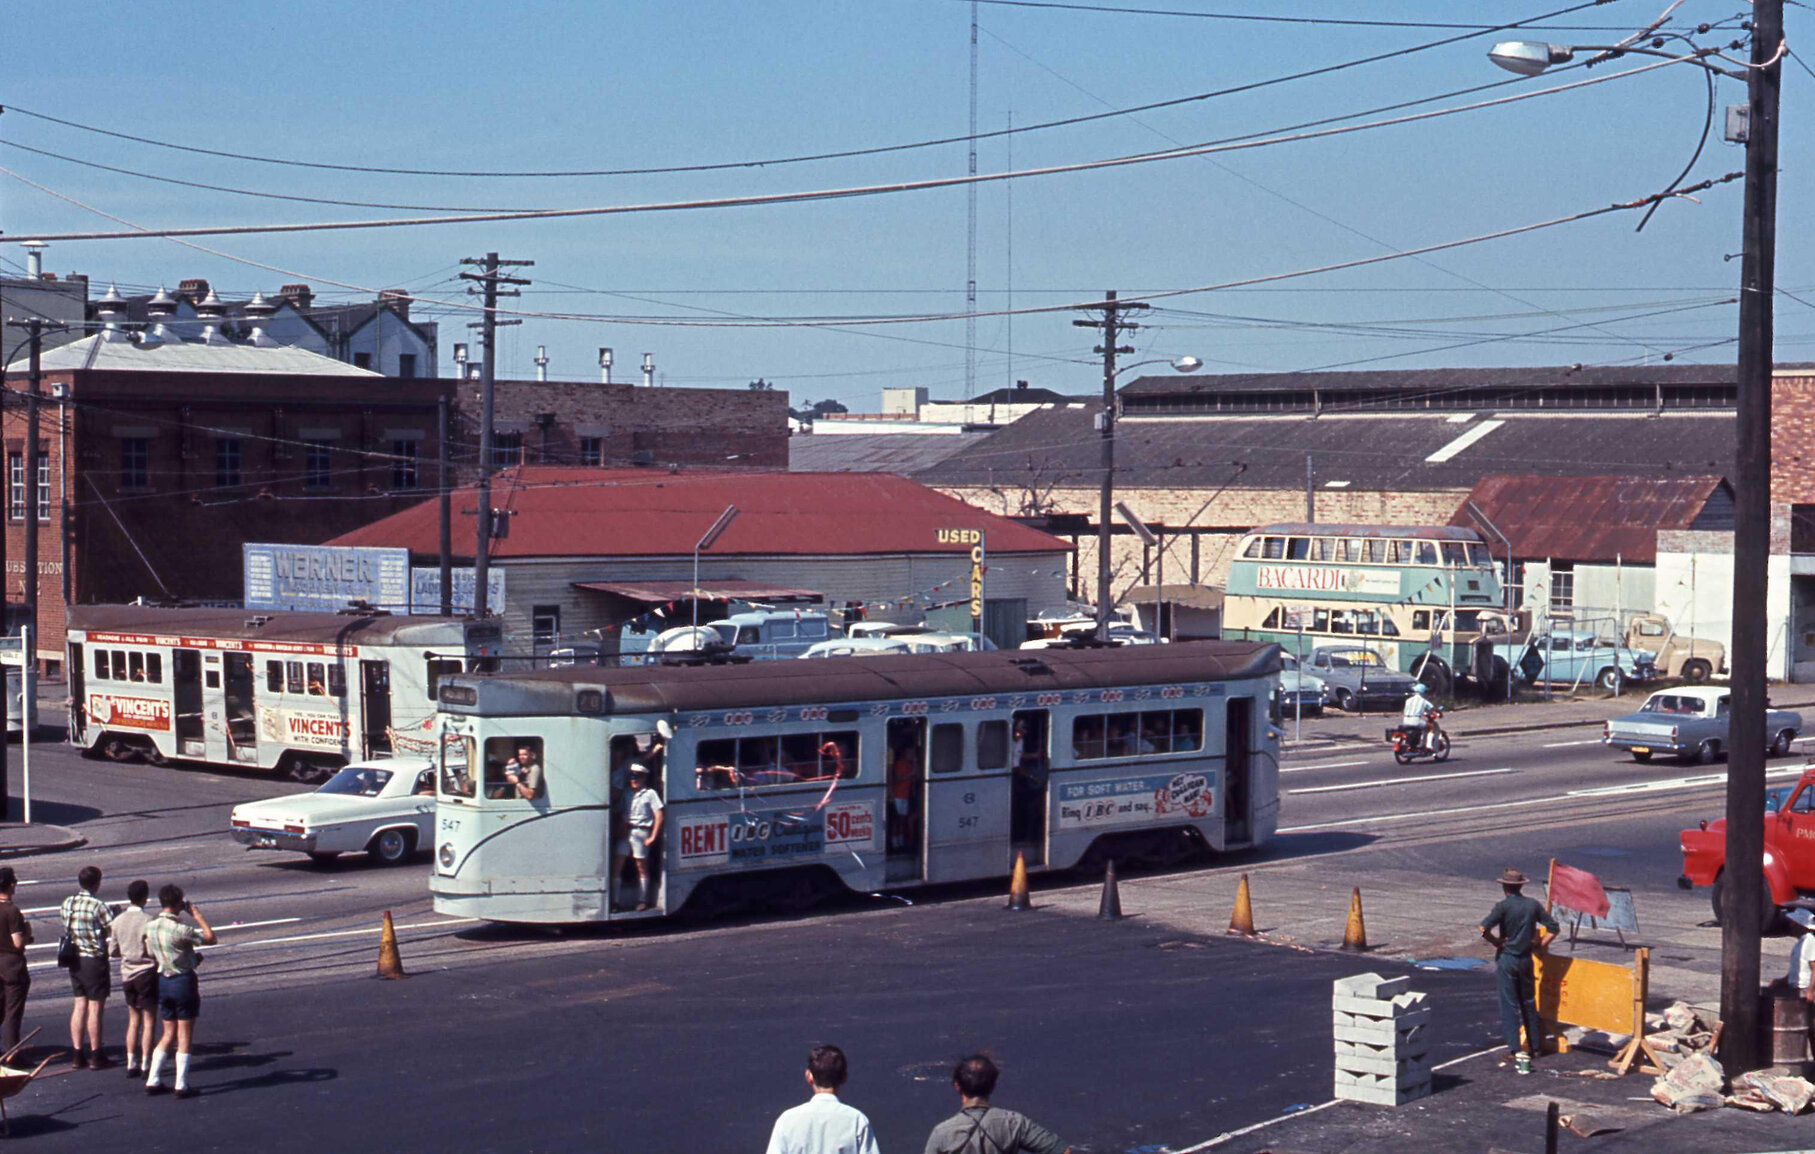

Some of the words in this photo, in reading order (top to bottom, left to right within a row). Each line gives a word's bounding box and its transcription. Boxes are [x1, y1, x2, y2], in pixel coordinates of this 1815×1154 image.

[938, 529, 980, 543] USED
[273, 551, 374, 583] WERNER
[971, 546, 982, 616] CARS
[1258, 565, 1340, 590] BACARDI
[1067, 786, 1085, 797] FOR
[1087, 784, 1111, 796] SOFT
[1061, 806, 1081, 821] Ring
[1118, 801, 1132, 814] and
[442, 818, 461, 832] 547
[827, 811, 851, 840] 50
[959, 815, 980, 829] 547
[681, 823, 728, 854] RENT
[731, 845, 766, 859] WATER
[771, 841, 821, 856] SOFTENER
